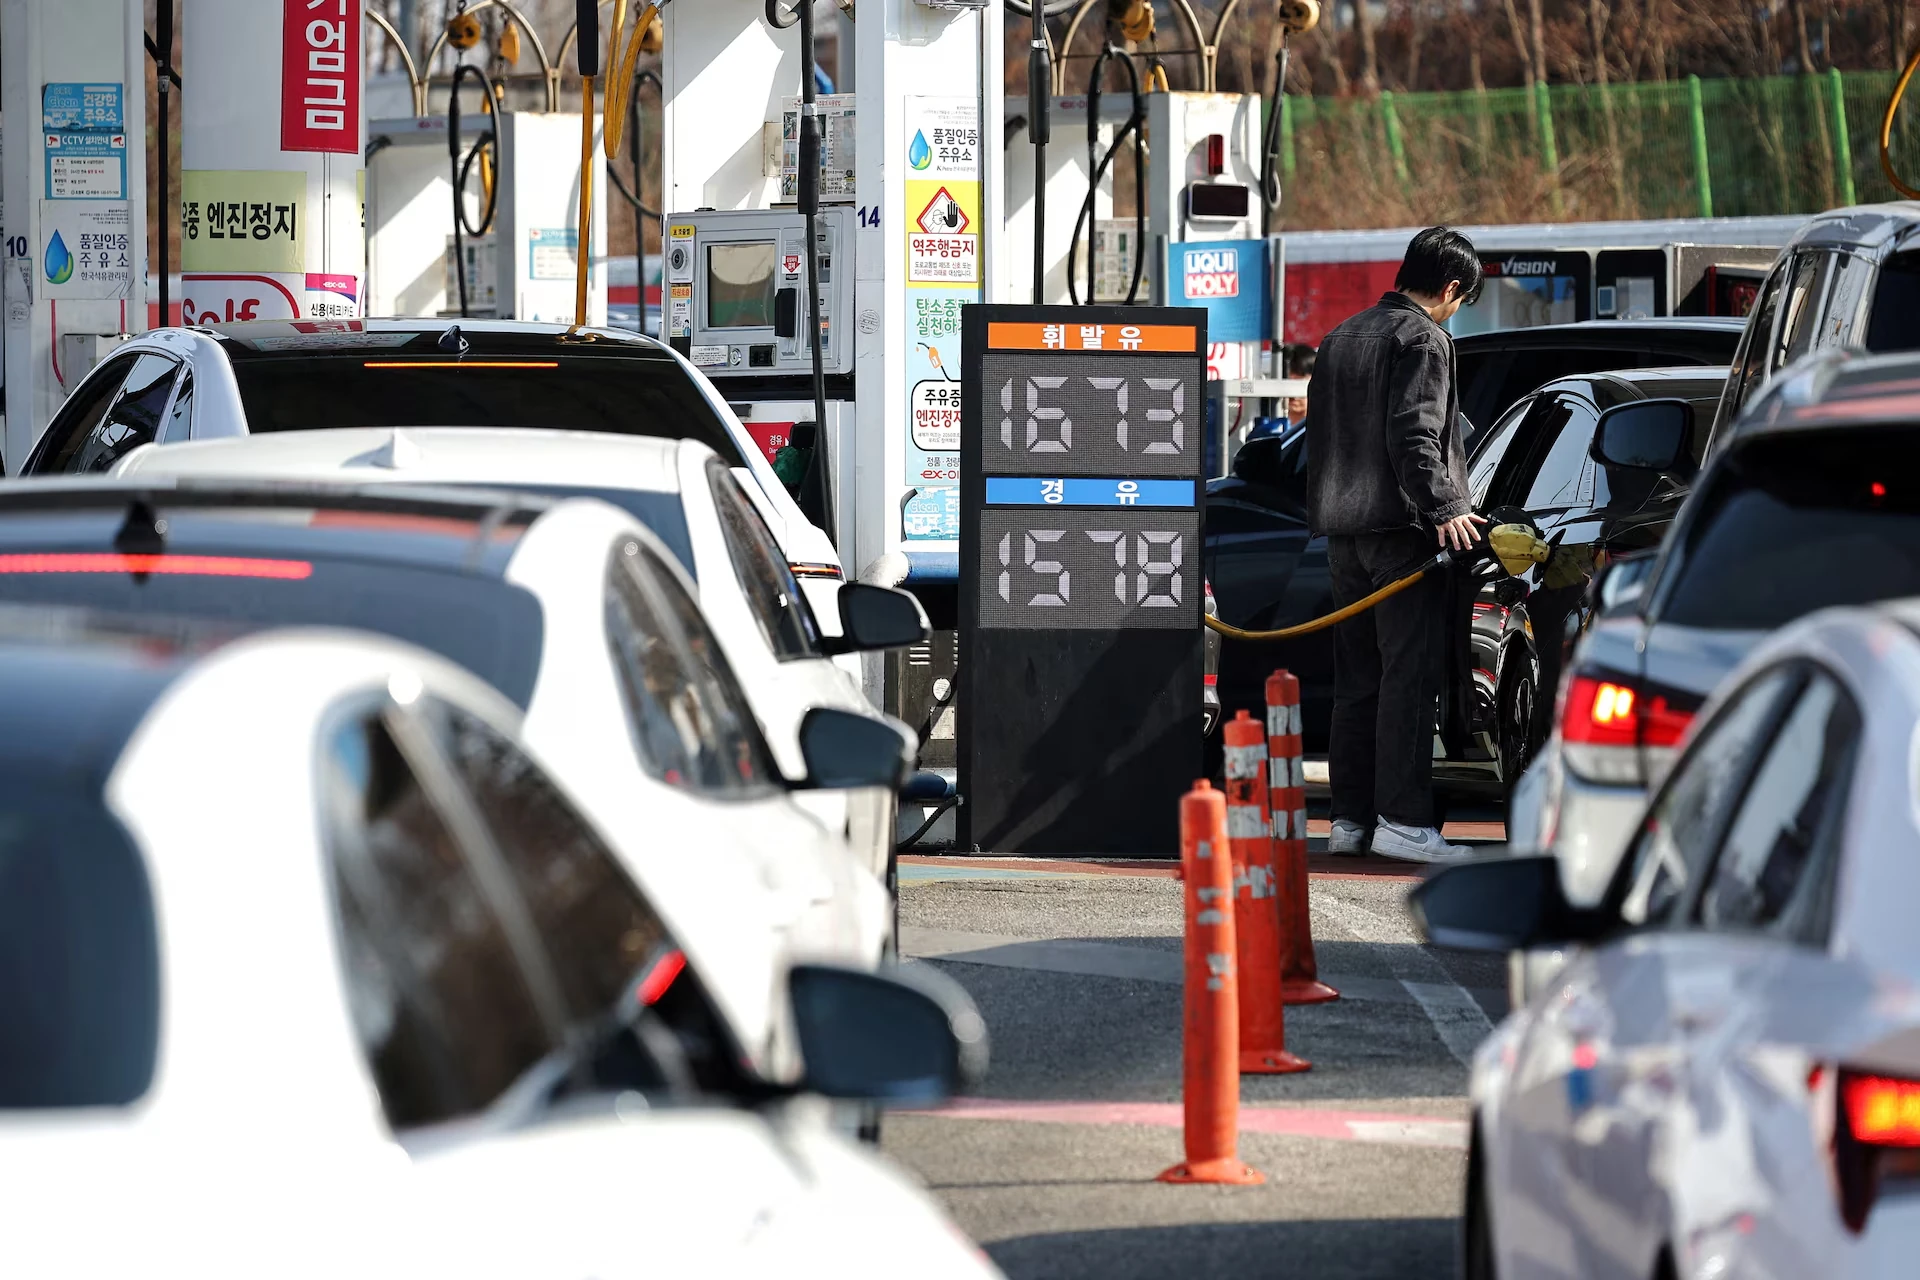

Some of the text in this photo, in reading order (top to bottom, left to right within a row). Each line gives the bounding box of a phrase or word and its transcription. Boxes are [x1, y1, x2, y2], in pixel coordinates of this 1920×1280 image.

[83, 93, 117, 107] 건강한
[83, 108, 117, 122] 주유소
[62, 135, 84, 145] CCTV
[933, 128, 978, 146] 품질인증
[938, 147, 973, 163] 주유소
[207, 202, 296, 240] 엔진정지
[857, 206, 881, 228] 14
[6, 236, 28, 257] 10
[80, 233, 129, 250] 품질인증
[912, 238, 974, 258] 역주행금지
[80, 251, 129, 268] 주유소
[1187, 252, 1234, 273] LIQUI
[80, 271, 128, 281] 한국석유관리원
[1187, 274, 1236, 295] MOLY
[916, 317, 962, 336] 실천하
[1041, 324, 1143, 350] 휘발유
[924, 389, 961, 407] 주유중
[1000, 376, 1184, 454] 1673
[769, 434, 783, 446] 경유
[909, 502, 939, 512] Clean
[998, 529, 1182, 608] 1578
